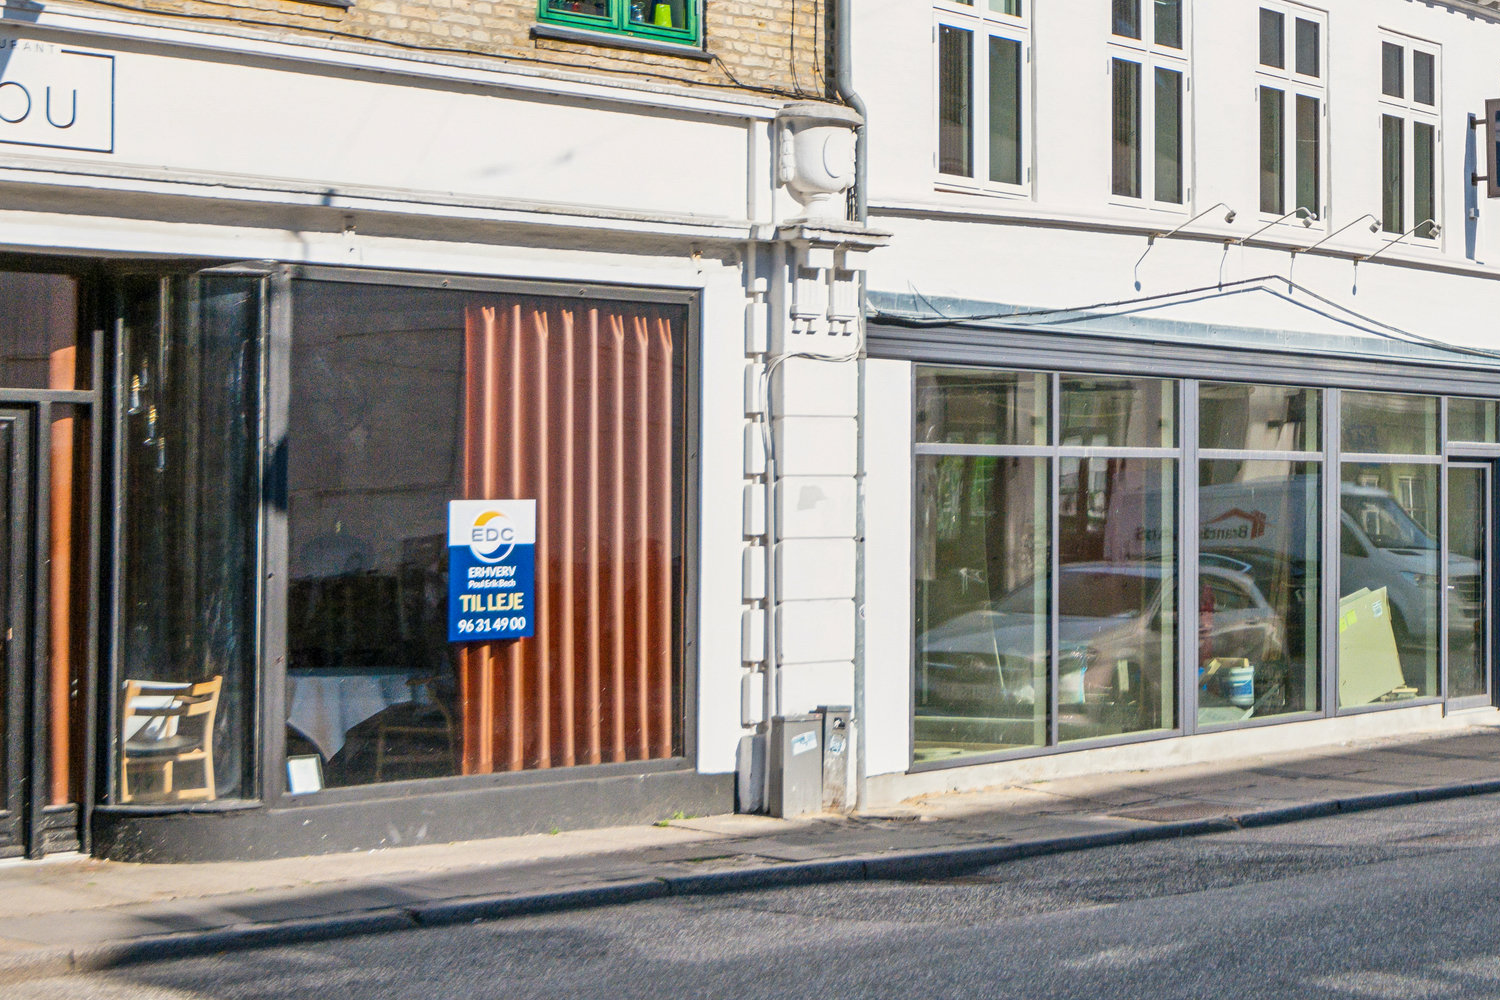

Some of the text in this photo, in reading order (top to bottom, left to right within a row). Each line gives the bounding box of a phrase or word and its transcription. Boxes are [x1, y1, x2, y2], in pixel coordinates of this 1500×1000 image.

[472, 528, 514, 542] EDC
[468, 565, 517, 579] ERHVERV
[459, 592, 525, 613] TIL LEJE
[458, 616, 526, 633] 96 31 49 00
